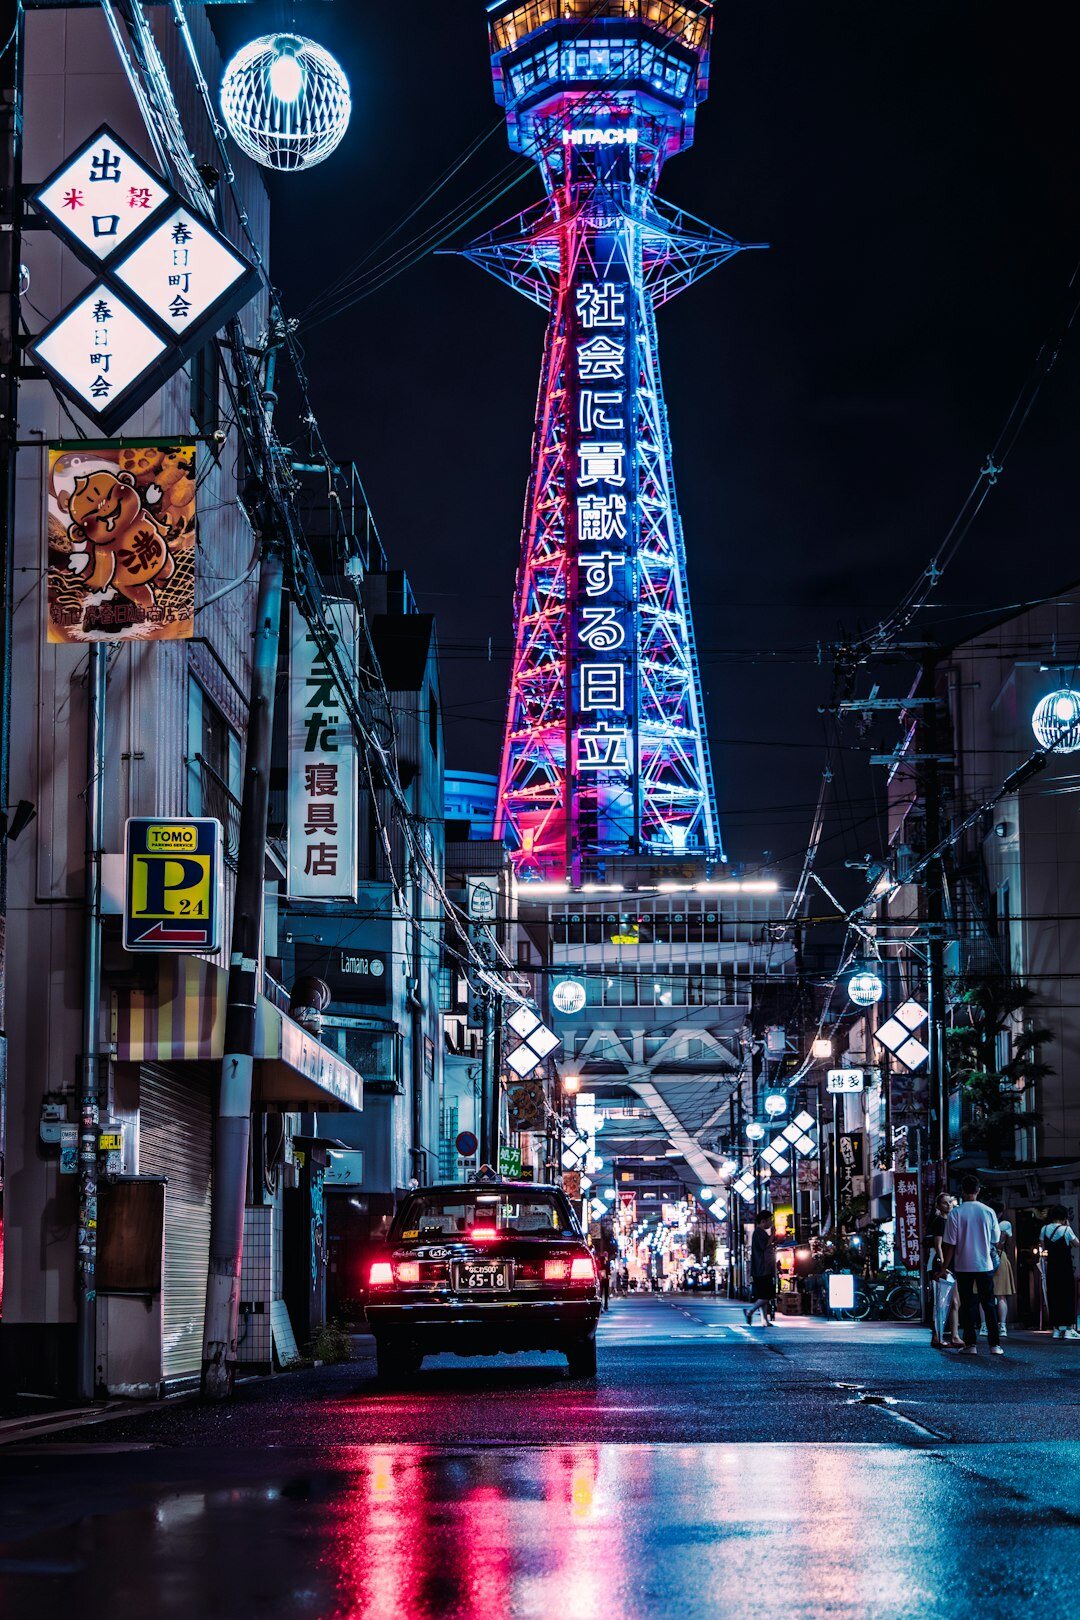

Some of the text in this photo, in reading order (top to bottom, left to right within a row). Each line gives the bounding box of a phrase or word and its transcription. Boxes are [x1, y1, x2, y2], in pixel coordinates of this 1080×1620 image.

[562, 128, 638, 145] HITACHI
[88, 148, 122, 238] 出口
[168, 222, 194, 318] 春日町会
[88, 300, 114, 398] 春日町会
[576, 282, 628, 770] 社会に貢献する日立
[117, 530, 163, 575] 満
[152, 831, 193, 842] TOMO
[135, 857, 204, 915] P
[179, 899, 205, 916] 24
[831, 1074, 859, 1088] 博多
[500, 1148, 520, 1162] 処方
[500, 1164, 519, 1176] せん
[897, 1179, 918, 1196] 奉納
[905, 1201, 920, 1266] 稲荷大明神
[468, 1273, 504, 1287] 65-18
